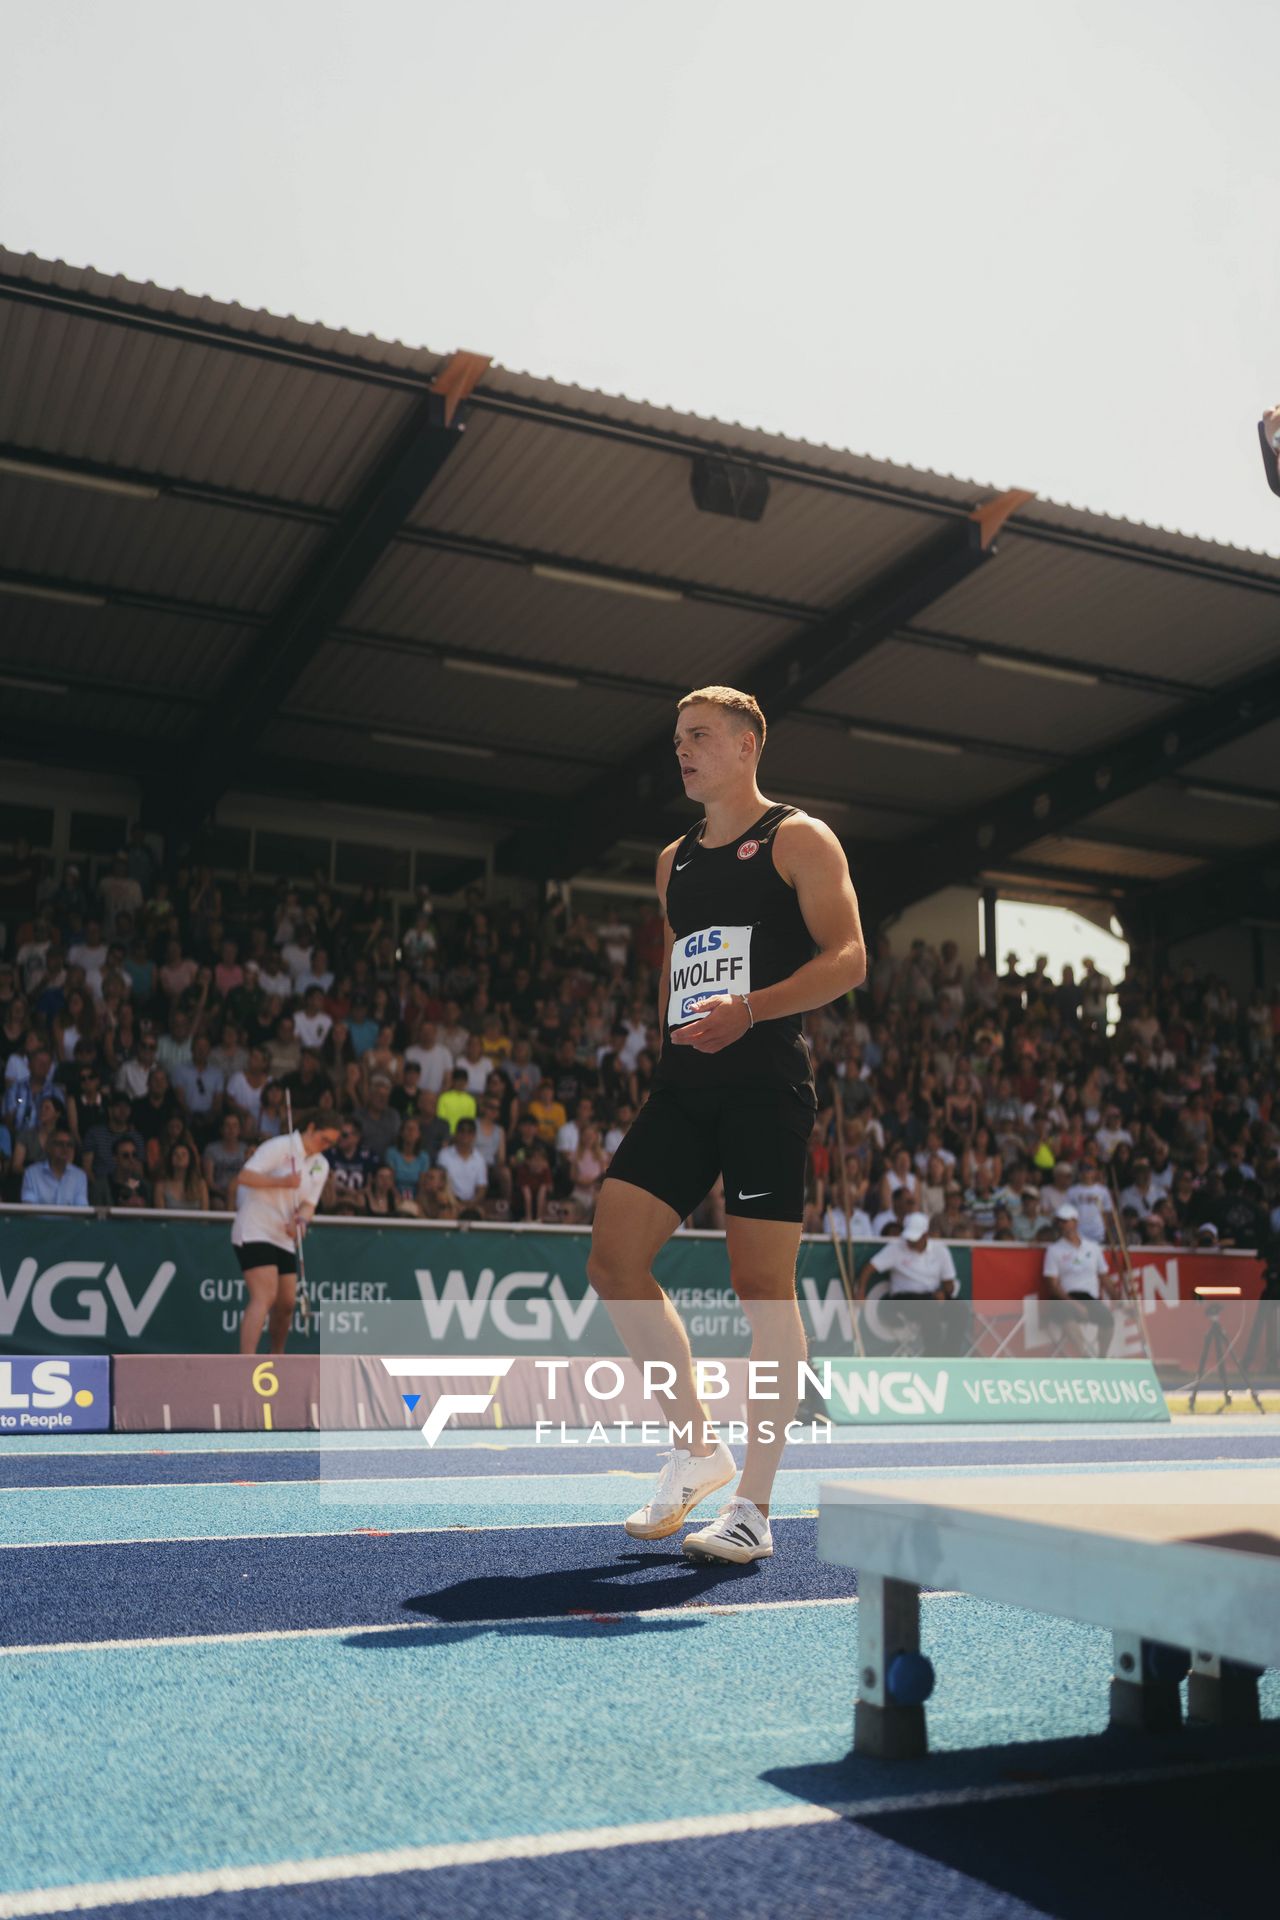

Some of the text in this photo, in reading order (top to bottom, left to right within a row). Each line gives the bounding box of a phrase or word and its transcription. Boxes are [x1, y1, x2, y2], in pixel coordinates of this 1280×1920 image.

[673, 956, 743, 992] WOLFF
[200, 1279, 246, 1301] GUT
[414, 1268, 600, 1341] WGV
[329, 1311, 368, 1333] IST.
[690, 1315, 729, 1337] GUT
[252, 1361, 279, 1397] 6
[831, 1370, 1158, 1415] WGV VERSICHERUNG
[20, 1413, 73, 1428] People
